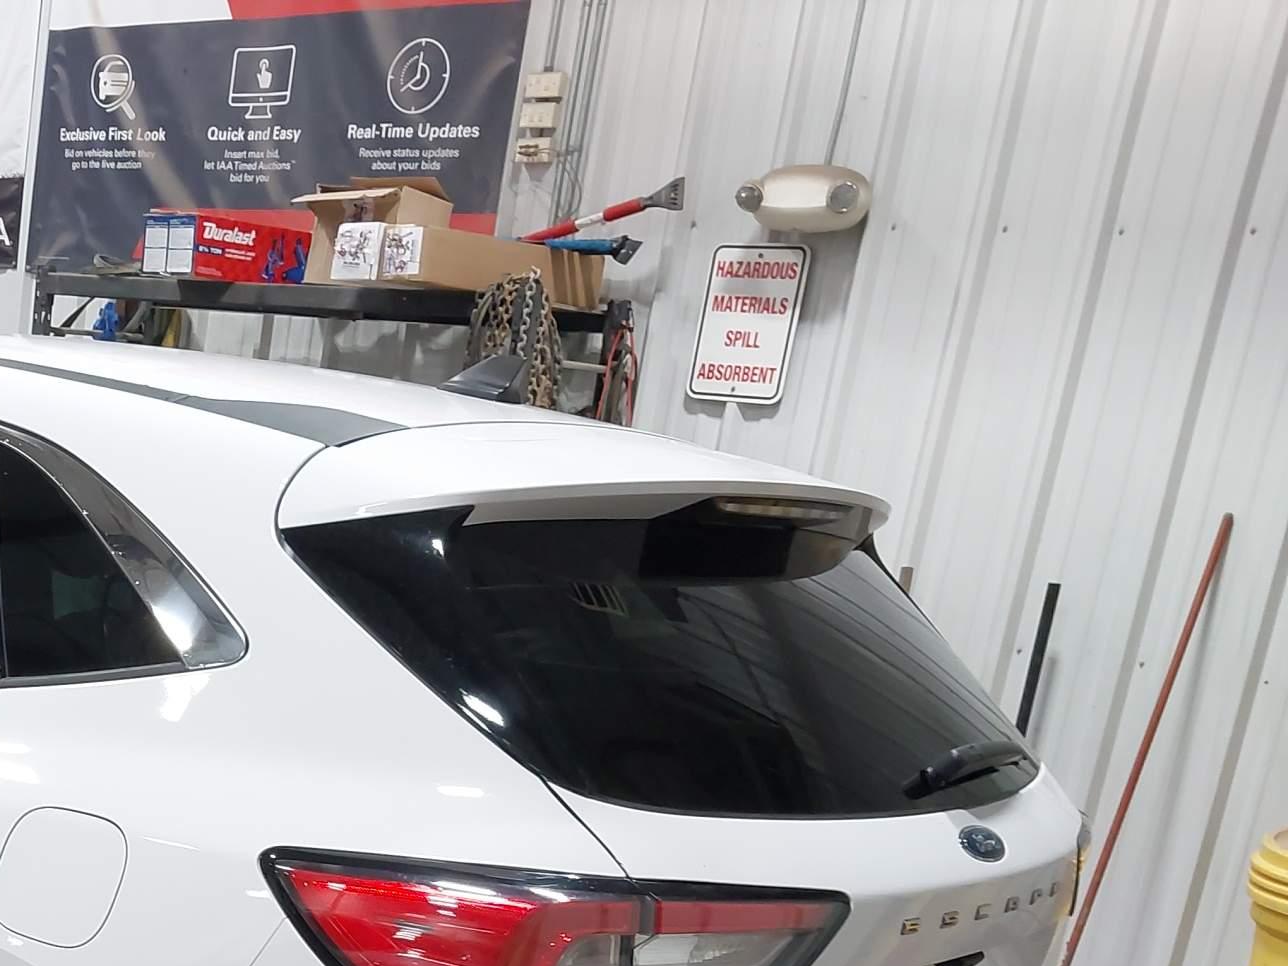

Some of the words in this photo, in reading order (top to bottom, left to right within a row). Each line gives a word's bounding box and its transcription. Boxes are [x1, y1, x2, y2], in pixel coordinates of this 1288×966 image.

[60, 126, 106, 141] Exclusive
[108, 126, 133, 140] First
[136, 127, 166, 141] Look
[207, 126, 245, 141] Quick
[247, 126, 271, 141] and
[273, 126, 302, 143] Easy
[347, 123, 414, 139] Real-Time
[418, 123, 480, 141] Updates
[64, 149, 74, 158] Bid
[84, 148, 113, 158] vehicles
[114, 148, 136, 158] before
[138, 149, 155, 159] they
[224, 149, 247, 159] Insert
[359, 147, 392, 158] Receive
[393, 148, 420, 158] status
[422, 148, 460, 159] updates
[72, 162, 80, 171] go
[89, 160, 100, 168] the
[102, 160, 115, 168] live
[116, 160, 142, 169] auction
[204, 160, 215, 170] let
[217, 161, 233, 170] IAA
[234, 161, 257, 170] Timed
[371, 160, 396, 170] about
[398, 161, 419, 172] your
[421, 160, 441, 170] bids
[230, 173, 243, 182] bid
[244, 172, 254, 182] for
[256, 174, 270, 184] you
[203, 221, 256, 246] Duralast
[716, 260, 799, 280] HAZARDOUS
[712, 295, 788, 315] MATERIALS
[724, 330, 760, 348] SPILL
[697, 363, 777, 385] ABSORBENT
